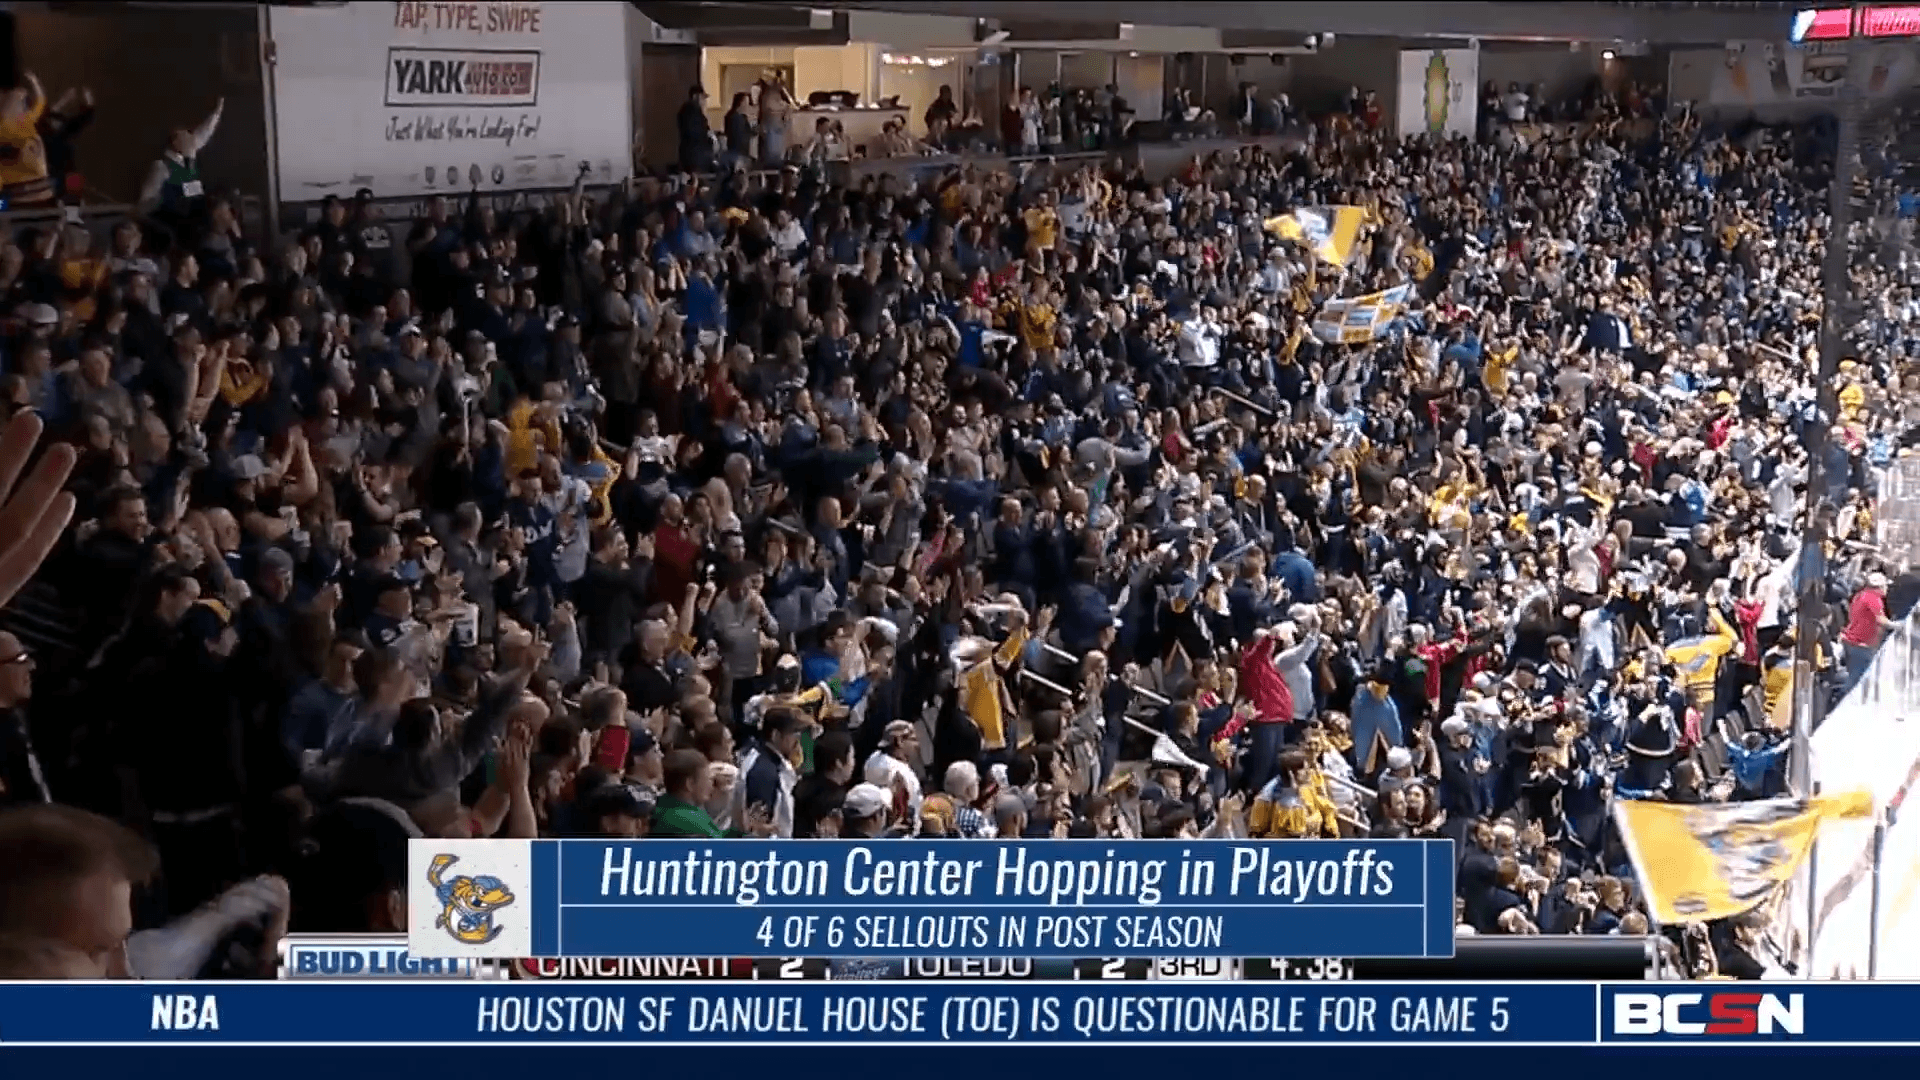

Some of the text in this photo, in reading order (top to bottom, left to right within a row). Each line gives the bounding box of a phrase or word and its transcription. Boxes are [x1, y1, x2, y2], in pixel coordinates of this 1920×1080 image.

[434, 4, 482, 36] TYPE,
[487, 5, 541, 33] SWIPE
[394, 59, 466, 94] YARK
